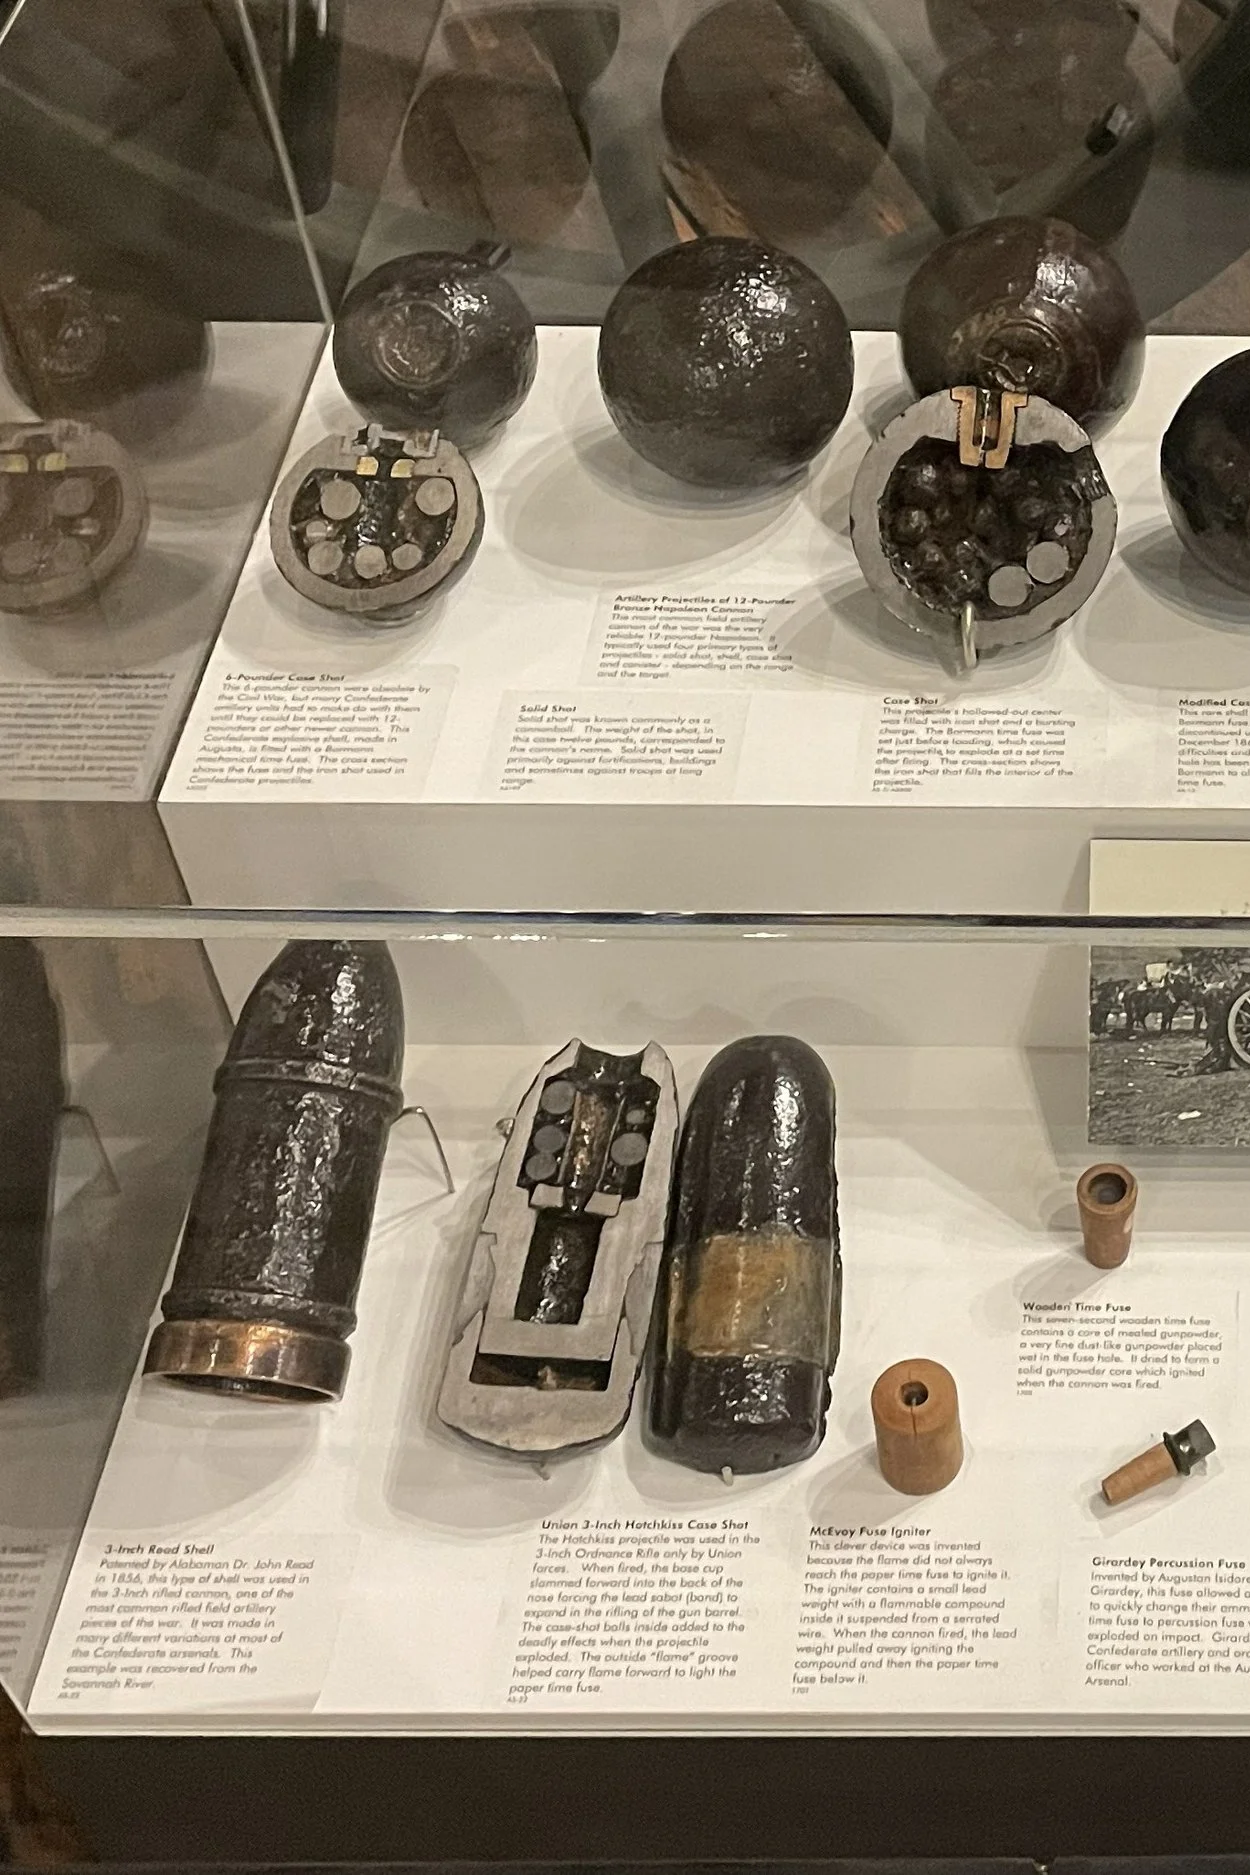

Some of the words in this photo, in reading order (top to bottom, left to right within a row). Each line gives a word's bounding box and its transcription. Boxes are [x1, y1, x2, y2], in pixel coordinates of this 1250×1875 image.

[883, 696, 910, 705] Case
[914, 696, 938, 705] Shot
[520, 704, 548, 712] Solid
[551, 704, 576, 713] Shot
[1023, 1302, 1070, 1311] Wooden
[1075, 1302, 1102, 1311] Time
[1105, 1302, 1131, 1312] Fuse
[1016, 1378, 1045, 1387] when
[1048, 1378, 1065, 1388] the
[1068, 1380, 1108, 1388] cannon
[1111, 1381, 1132, 1389] was
[541, 1520, 578, 1529] Union
[582, 1519, 621, 1529] 3-Inch
[625, 1519, 683, 1529] Hotchkiss
[687, 1519, 717, 1529] Case
[721, 1519, 748, 1529] Shot
[809, 1526, 855, 1538] McEvoy
[859, 1526, 887, 1537] Fuse
[891, 1526, 931, 1539] Igniter
[104, 1544, 144, 1554] 3-Inch
[148, 1544, 180, 1554] Read
[183, 1544, 214, 1554] Shell
[535, 1548, 571, 1558] 3-Inch
[575, 1548, 633, 1558] Ordnance
[635, 1548, 660, 1558] Rifle
[663, 1548, 688, 1561] only
[690, 1548, 705, 1561] by
[708, 1548, 742, 1559] Union
[806, 1554, 853, 1565] because
[856, 1554, 874, 1565] the
[877, 1554, 909, 1565] flame
[912, 1554, 931, 1565] did
[934, 1556, 953, 1565] not
[955, 1555, 992, 1567] always
[1092, 1556, 1146, 1569] Girardey
[1149, 1557, 1214, 1568] Percussion
[1217, 1558, 1246, 1569] Fuse
[94, 1573, 106, 1583] in
[147, 1573, 168, 1583] this
[170, 1573, 195, 1585] type
[197, 1573, 212, 1583] of
[213, 1573, 240, 1583] shell
[243, 1576, 265, 1584] was
[268, 1574, 296, 1584] used
[298, 1574, 309, 1584] in
[1090, 1586, 1143, 1598] Girardey,
[1146, 1586, 1166, 1597] this
[1169, 1587, 1193, 1597] fuse
[1196, 1587, 1241, 1598] allowed
[799, 1613, 833, 1623] inside
[836, 1614, 844, 1623] it
[847, 1613, 908, 1625] suspended
[911, 1613, 938, 1623] from
[941, 1615, 950, 1623] a
[953, 1613, 1000, 1623] serrated
